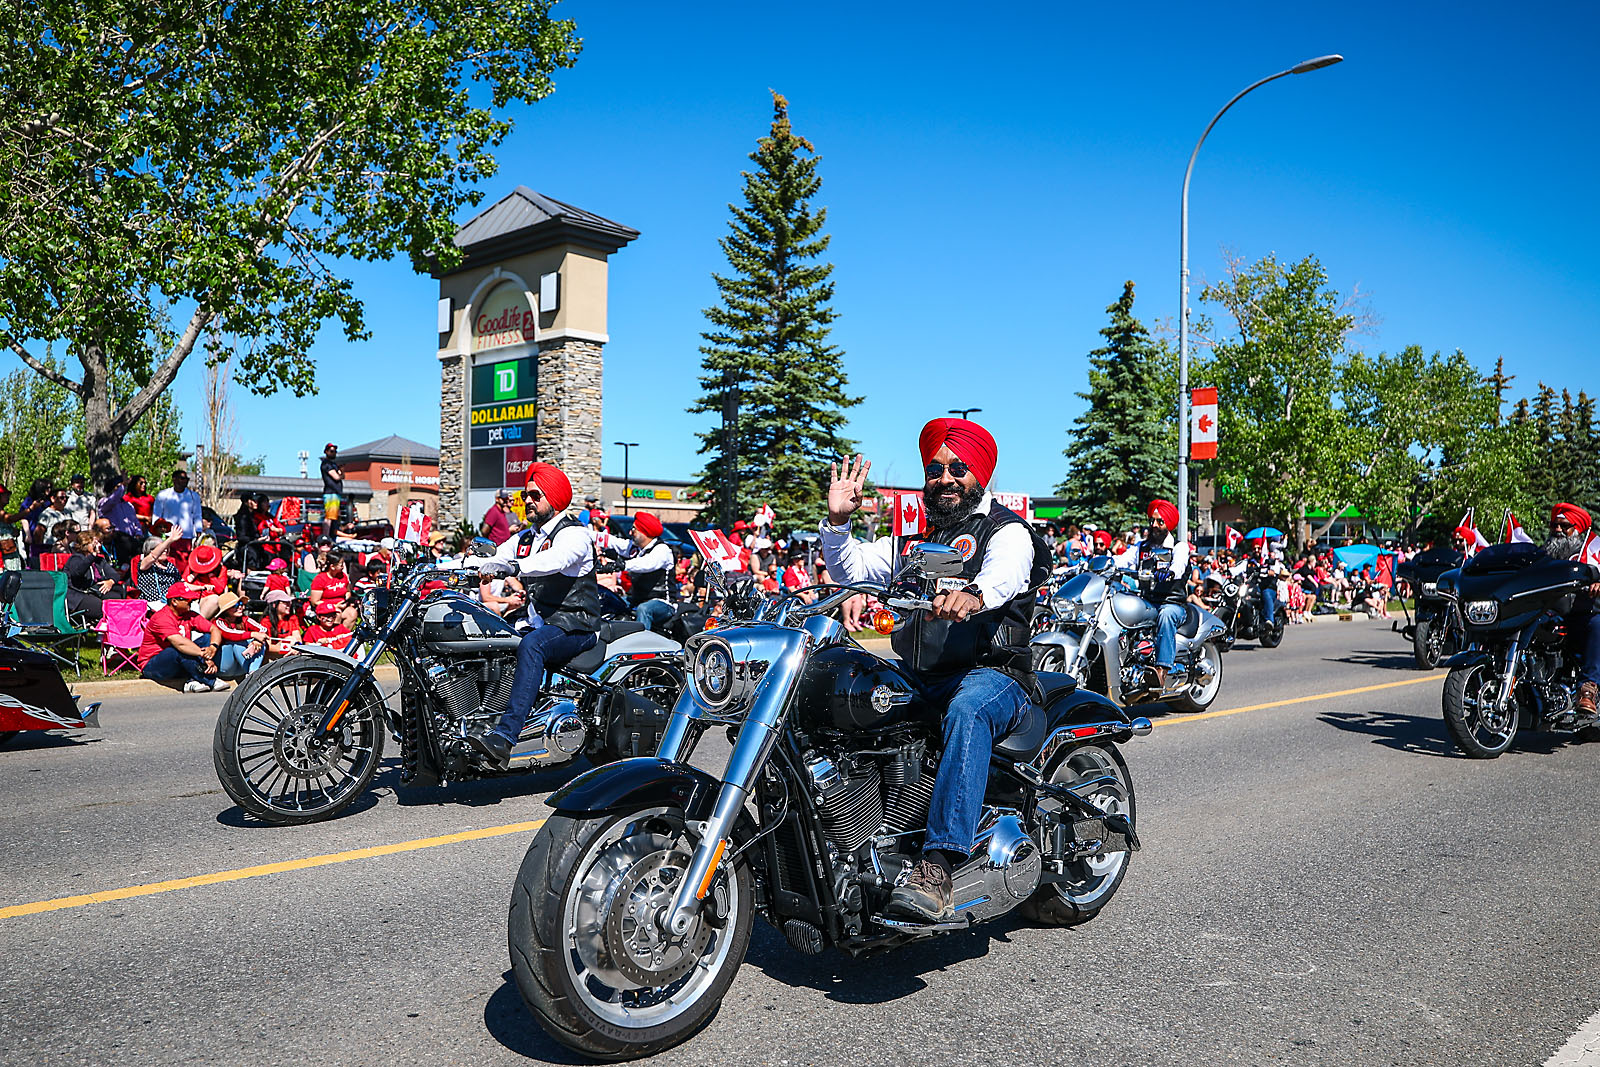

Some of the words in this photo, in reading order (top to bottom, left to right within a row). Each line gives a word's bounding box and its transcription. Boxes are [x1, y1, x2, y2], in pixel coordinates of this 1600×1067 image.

[477, 305, 521, 334] GoodLife
[477, 328, 520, 350] FITNESS
[497, 369, 515, 392] TD
[382, 474, 414, 484] ANIMAL
[414, 475, 440, 486] HOSPI
[632, 488, 654, 499] cora
[993, 495, 1024, 511] APLES
